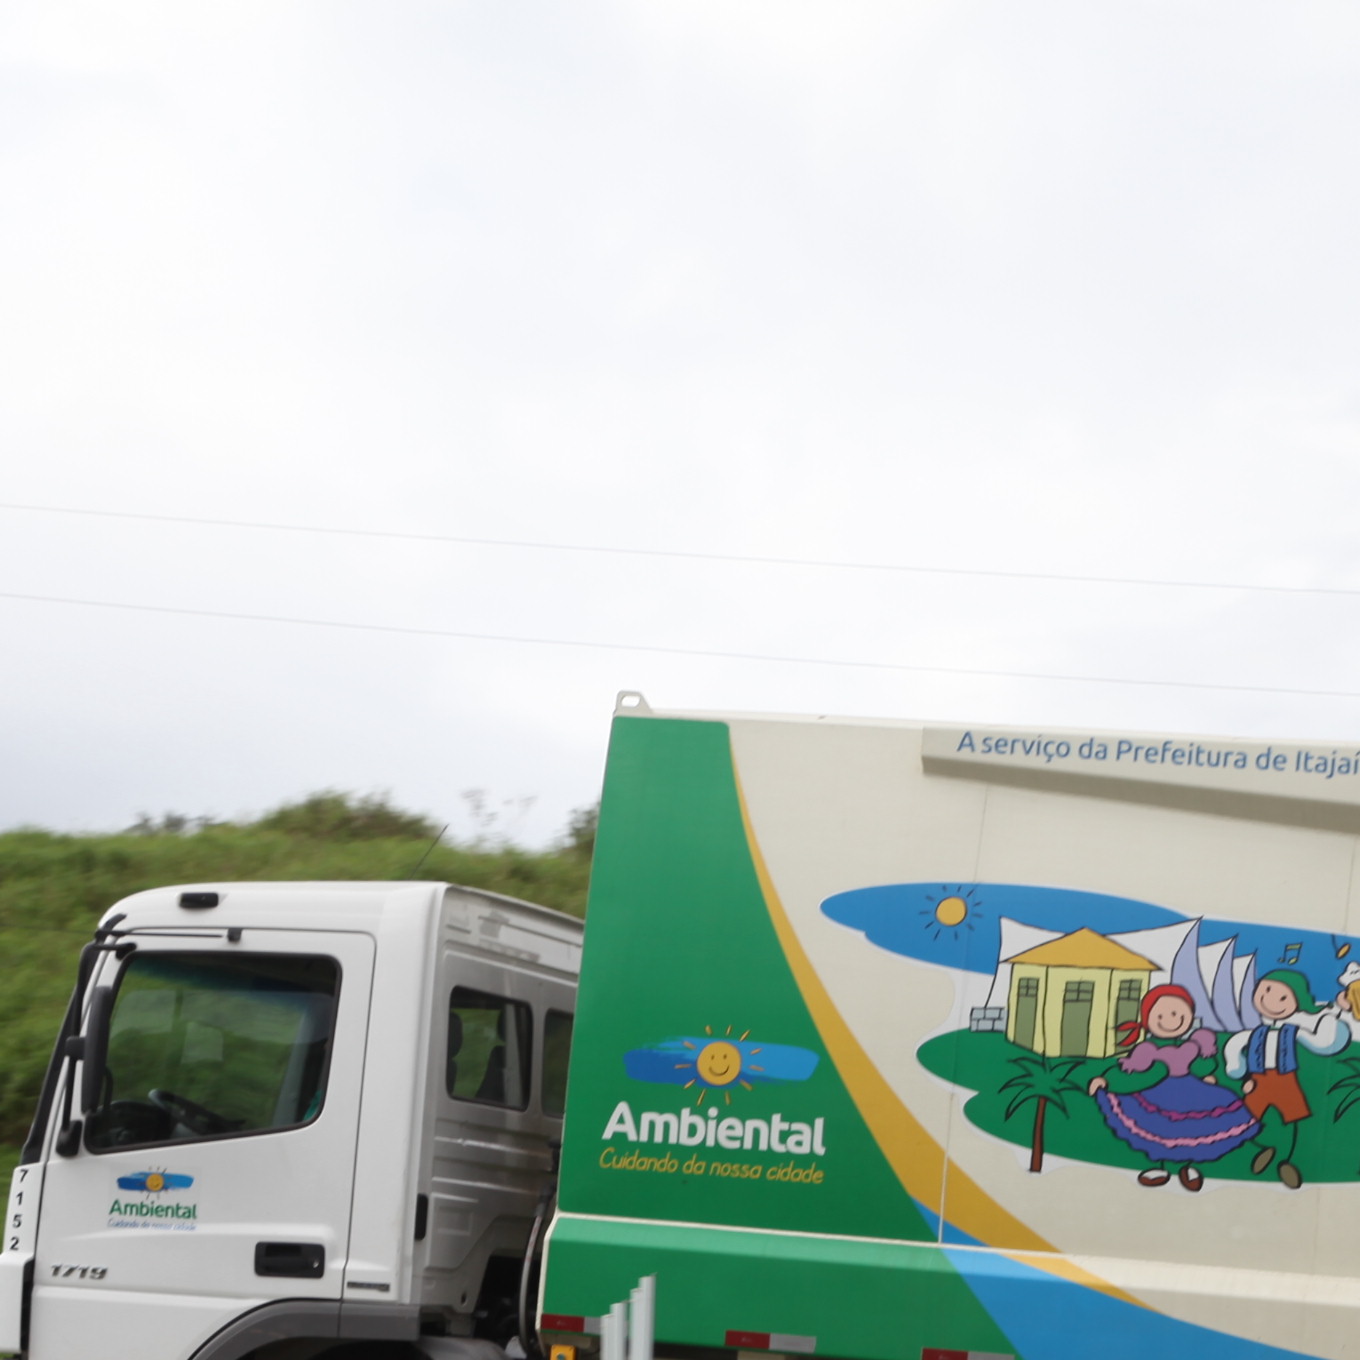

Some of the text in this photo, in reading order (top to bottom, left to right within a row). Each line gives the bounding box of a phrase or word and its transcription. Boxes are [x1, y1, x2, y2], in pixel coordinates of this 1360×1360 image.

[956, 730, 976, 753] A
[981, 734, 1071, 763] serviço
[1078, 737, 1108, 761] da
[1115, 739, 1248, 770] Prefeitura
[1254, 745, 1287, 772] de
[601, 1100, 826, 1156] Ambiental
[598, 1146, 825, 1184] Cuidando da nossa cidade
[108, 1199, 197, 1220] Ambiental
[51, 1264, 108, 1280] 1719
